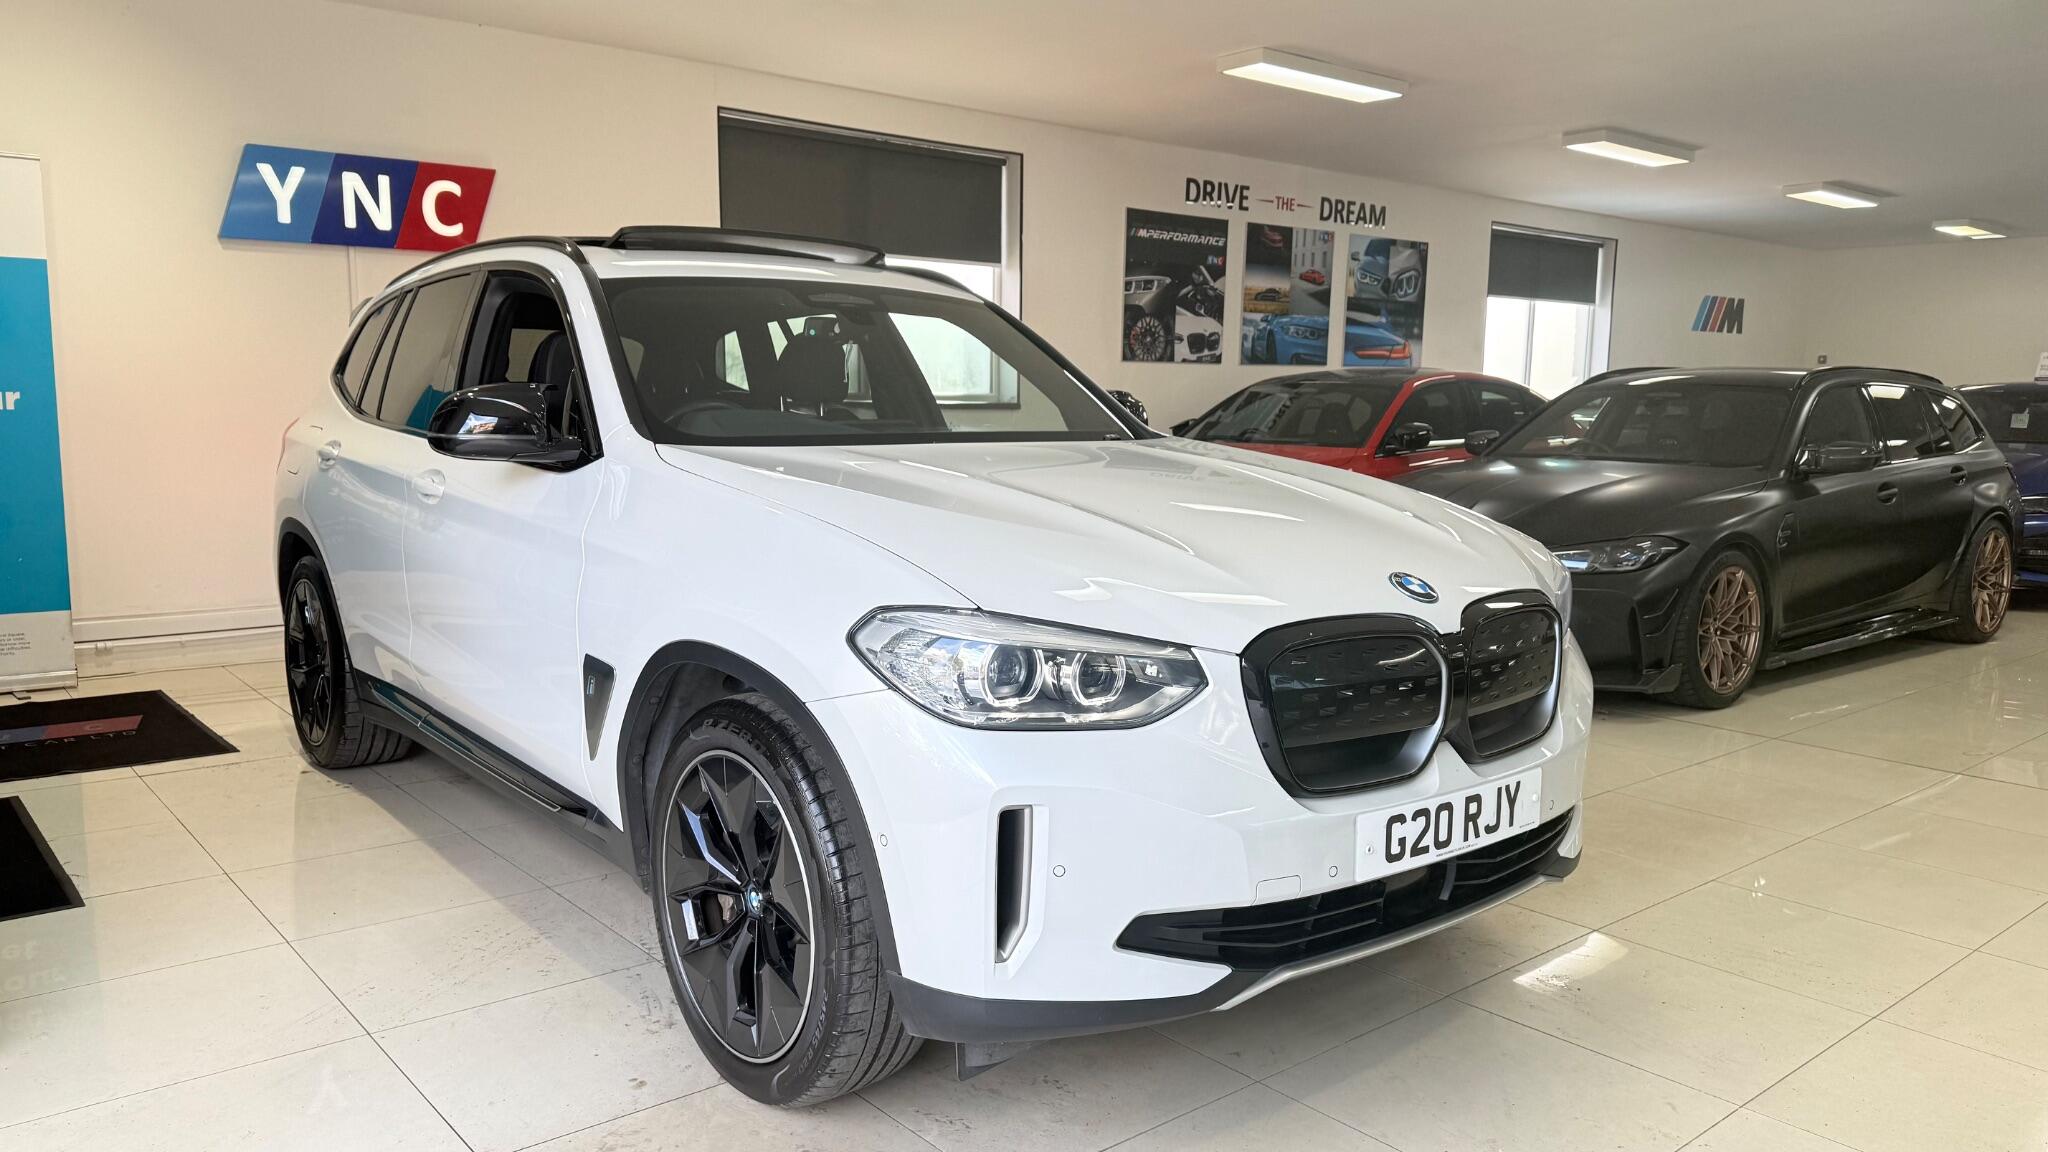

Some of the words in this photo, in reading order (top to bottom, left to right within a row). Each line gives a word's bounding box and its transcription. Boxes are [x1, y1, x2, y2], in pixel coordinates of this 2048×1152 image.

[256, 162, 464, 237] YNC
[1185, 177, 1250, 211] DRIVE
[1275, 196, 1296, 211] THE
[1320, 196, 1386, 228] DREAM
[1385, 801, 1454, 864] G20
[1463, 780, 1521, 843] RJY
